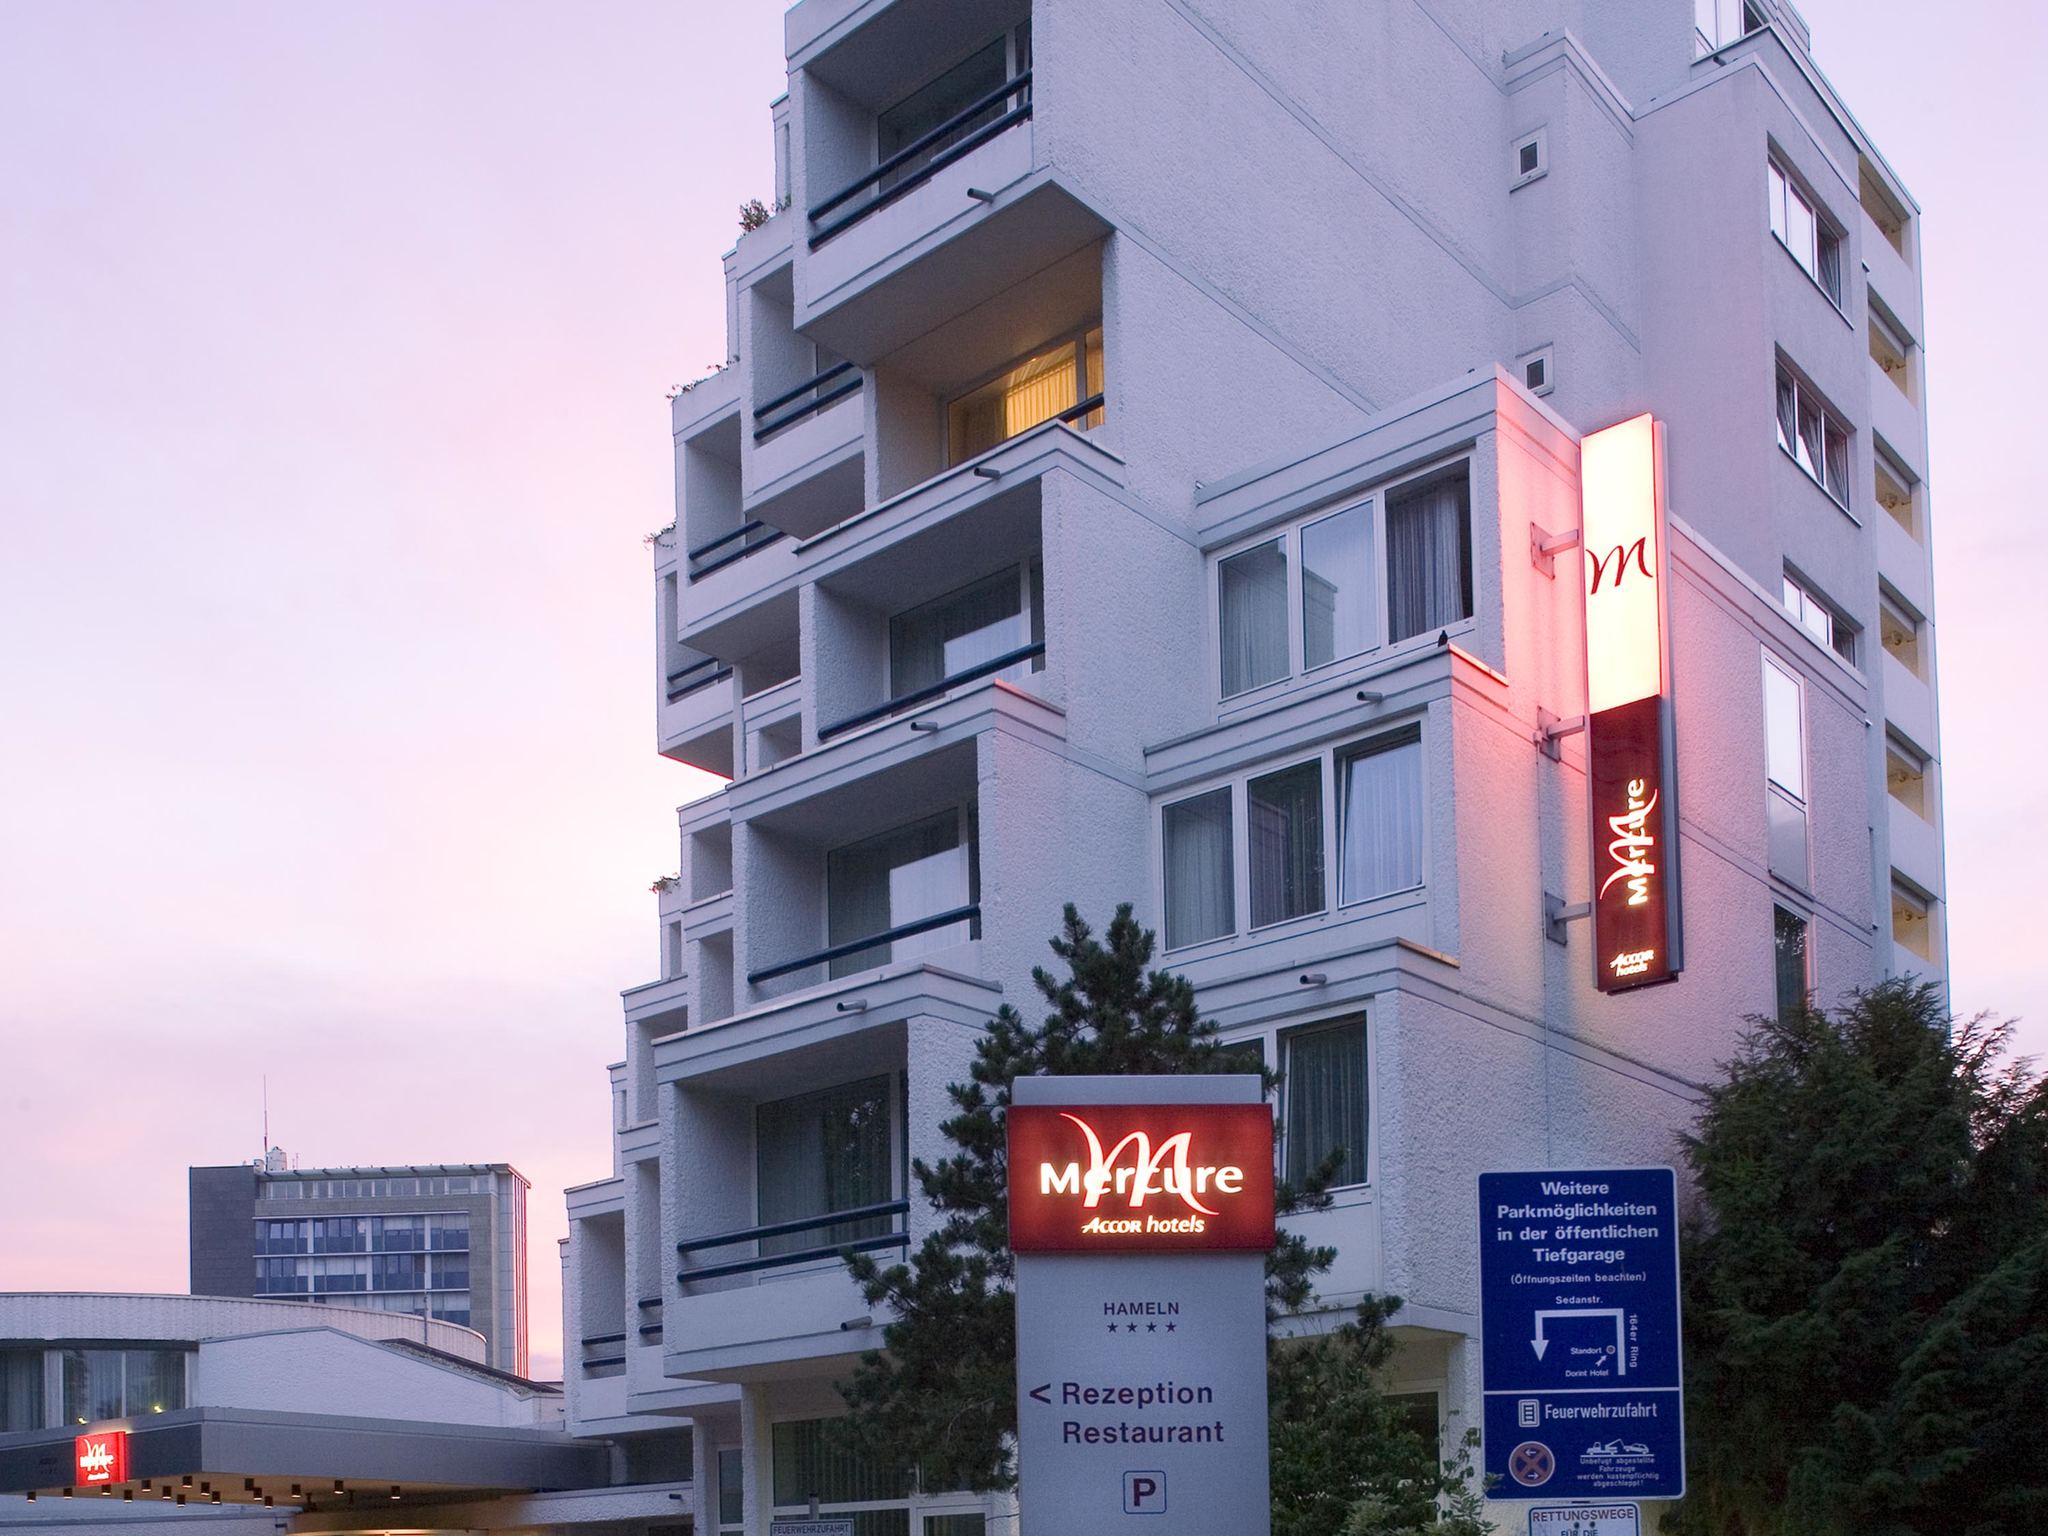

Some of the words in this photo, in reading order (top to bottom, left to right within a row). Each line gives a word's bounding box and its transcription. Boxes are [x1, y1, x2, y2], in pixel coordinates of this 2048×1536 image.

[1541, 1182, 1610, 1196] Weitere
[1497, 1202, 1658, 1221] Parkmöglichkeiten
[1146, 1214, 1206, 1233] hotels
[1497, 1227, 1513, 1241] in
[1519, 1226, 1548, 1241] der
[1554, 1224, 1659, 1240] öffentlichen
[1532, 1247, 1626, 1265] Tiefgarage
[1510, 1272, 1591, 1286] (Öffnungszeiten
[1594, 1270, 1647, 1283] beachten)
[1555, 1295, 1604, 1305] Sedanstr.
[1103, 1302, 1180, 1316] HAMELN
[1570, 1347, 1603, 1355] Standort
[1629, 1346, 1639, 1368] Ring
[1590, 1369, 1609, 1377] Hotel
[1062, 1381, 1213, 1410] Rezeption
[1545, 1402, 1658, 1420] Feuerwehrzufahrt
[1063, 1420, 1225, 1444] Restaurant
[1133, 1478, 1157, 1507] P
[1532, 1508, 1635, 1523] RETTUNGSWEGE
[773, 1523, 850, 1535] FEUERWEHRZUFAHRT
